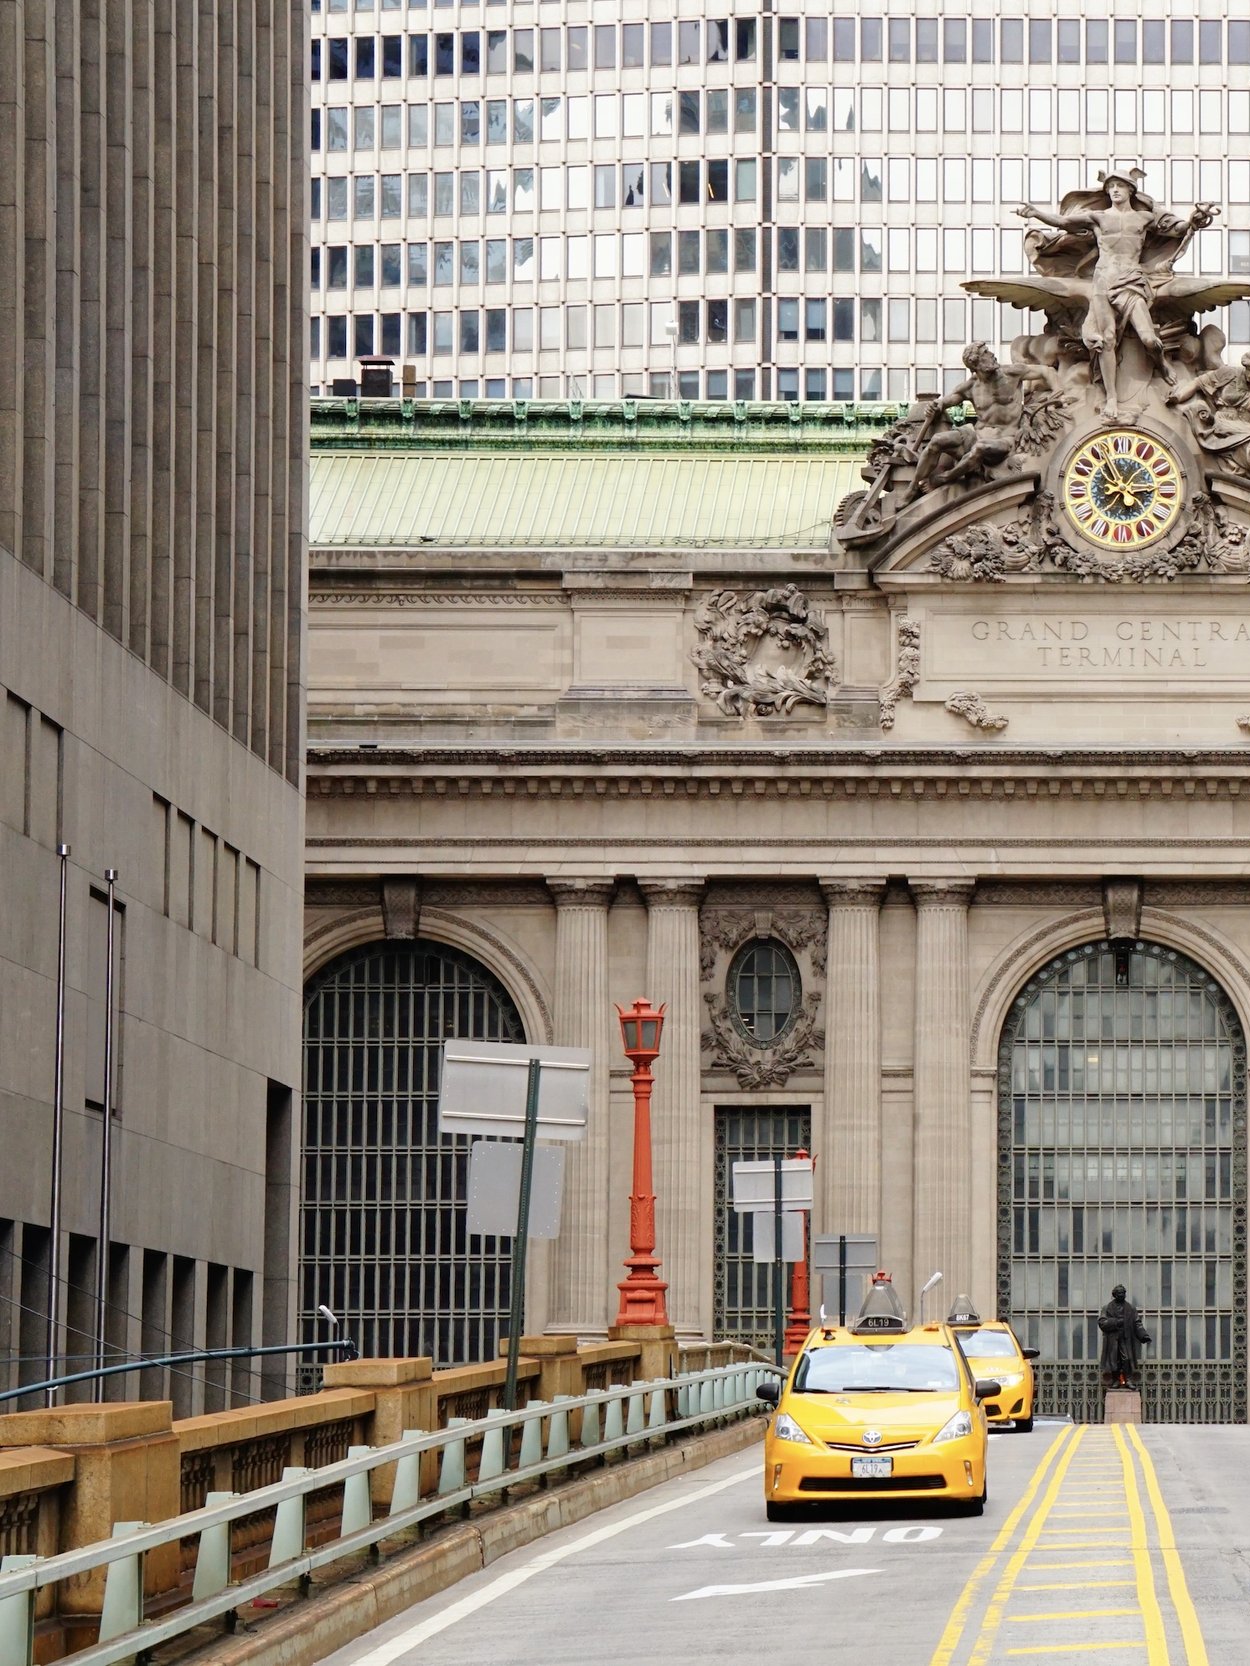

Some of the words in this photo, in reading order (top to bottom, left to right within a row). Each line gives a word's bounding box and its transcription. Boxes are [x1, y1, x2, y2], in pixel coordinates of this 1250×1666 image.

[971, 621, 1090, 641] GRAND
[1037, 647, 1208, 667] TERMINAL
[868, 1318, 890, 1328] 6L19
[664, 1526, 944, 1549] ONLY
